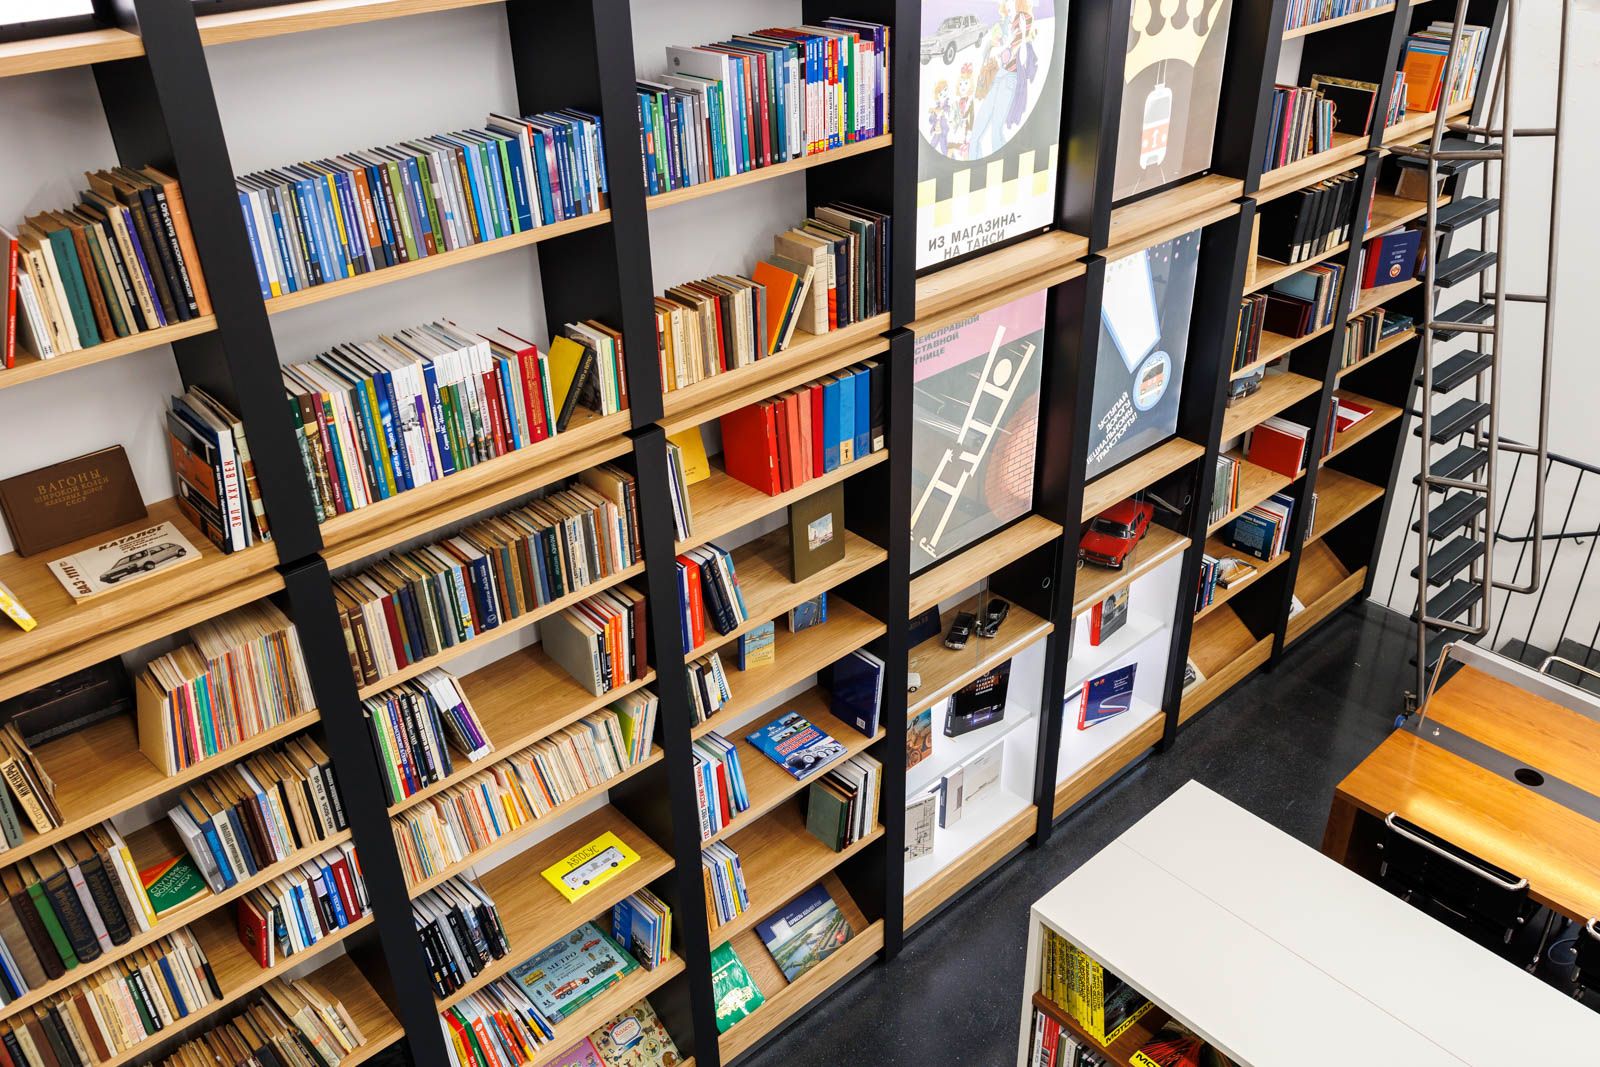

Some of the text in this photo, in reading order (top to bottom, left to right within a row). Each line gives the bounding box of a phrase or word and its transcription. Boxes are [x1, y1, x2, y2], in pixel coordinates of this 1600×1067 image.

[928, 212, 1022, 252] ИЗ МАГАЗИНА-
[943, 229, 1005, 260] НА ТАКСИ
[1097, 391, 1129, 430] УСТУПАЙ
[1105, 399, 1131, 433] ДОРОГУ
[37, 469, 102, 495] ВАГОНЫ
[224, 460, 235, 478] ВЕК
[230, 508, 242, 527] ЗИЛ
[98, 524, 165, 552] КАТАЛОГ
[2, 762, 30, 798] ИНЖЕНЕРЫ
[566, 845, 600, 869] АВТОБУС
[150, 866, 182, 894] СПУТНИК
[154, 865, 190, 898] ВОДИТЕЛЯ
[170, 874, 192, 894] ТАКСИ
[546, 951, 578, 972] МЕТРО
